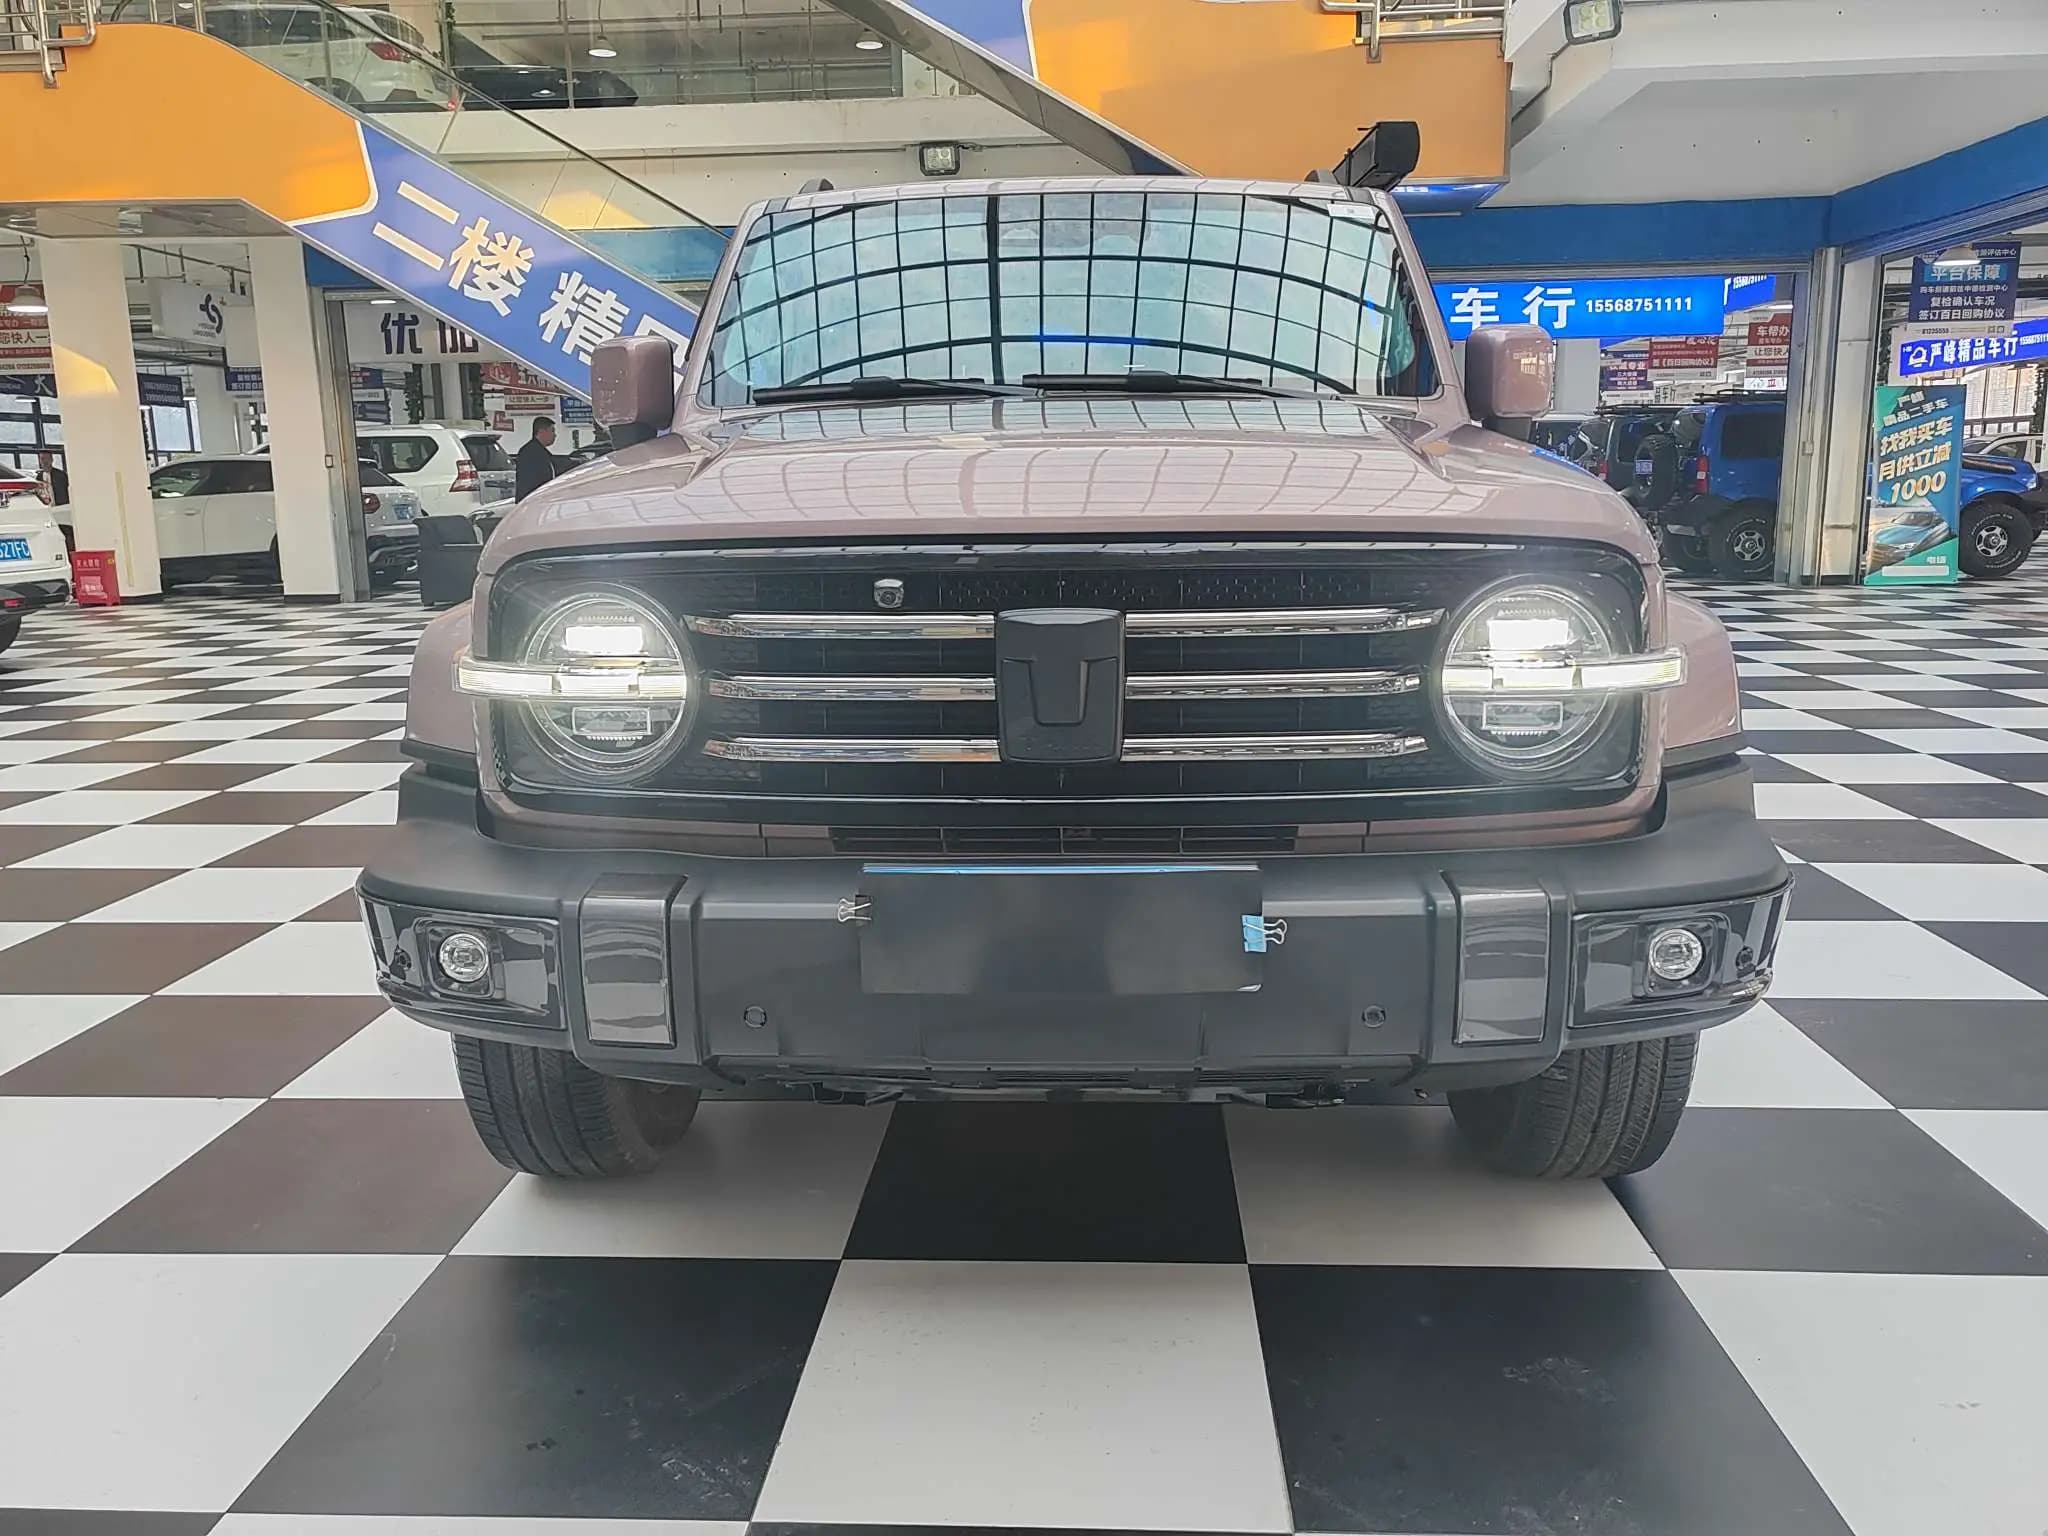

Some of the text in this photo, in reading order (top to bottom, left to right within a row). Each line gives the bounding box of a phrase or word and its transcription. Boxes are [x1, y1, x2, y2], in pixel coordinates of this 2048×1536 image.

[372, 181, 534, 317] 二楼
[1931, 264, 2001, 281] 平台保障
[1585, 296, 1693, 313] 15568751111
[1930, 296, 1996, 308] 复检确认车况
[1919, 308, 2006, 321] 签订百日回购协议
[0, 330, 51, 345] 您快人一
[1929, 336, 2019, 367] 严峰精品车行
[1880, 415, 1954, 457] 找我买车
[1878, 441, 1952, 483] 月供立减
[1890, 470, 1948, 504] 1000
